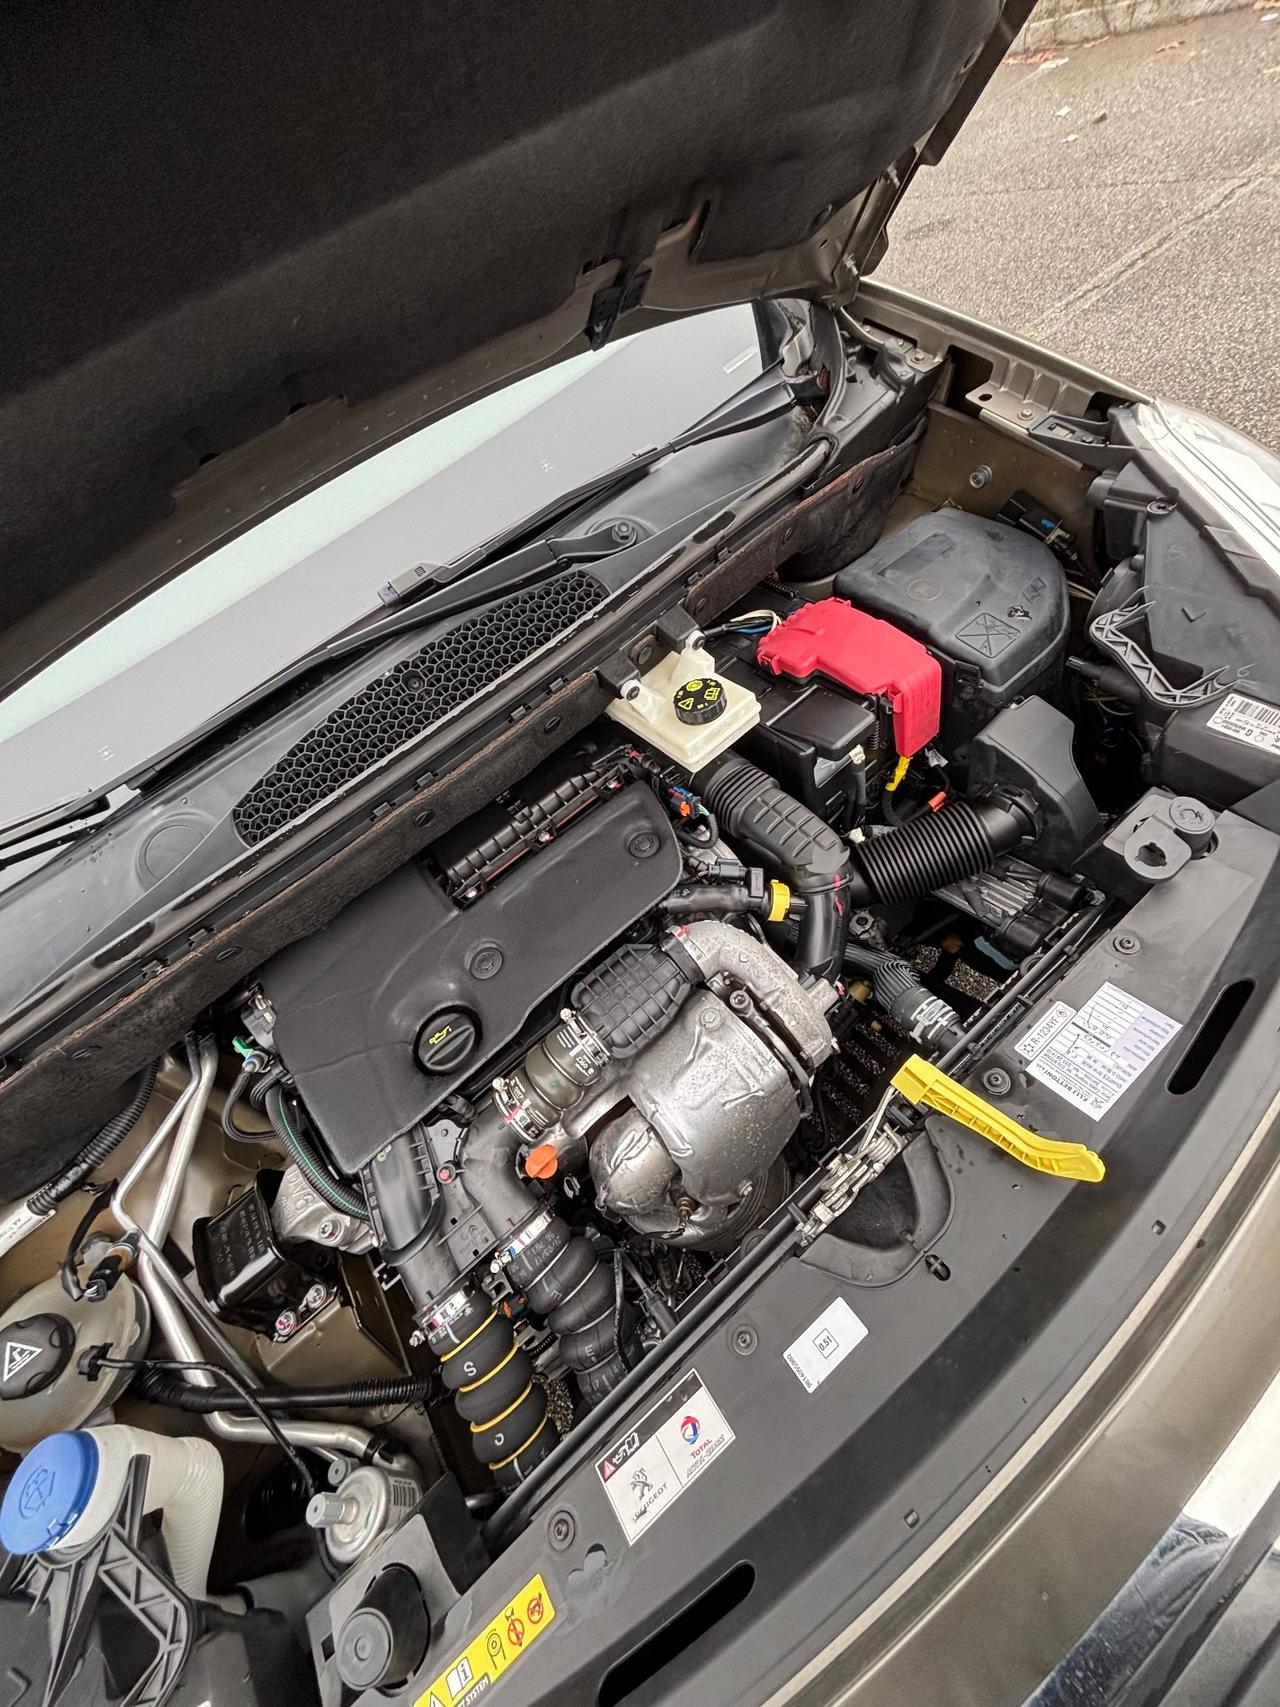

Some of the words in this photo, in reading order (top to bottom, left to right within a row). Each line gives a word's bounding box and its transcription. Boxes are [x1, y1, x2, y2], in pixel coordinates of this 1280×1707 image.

[1032, 1017, 1060, 1046] R-1234YF
[1043, 1069, 1072, 1090] BETTONI
[818, 1336, 833, 1351] 0.51
[463, 1361, 477, 1376] S
[690, 1438, 713, 1460] TOTAL
[465, 1676, 489, 1707] SYSTEM
